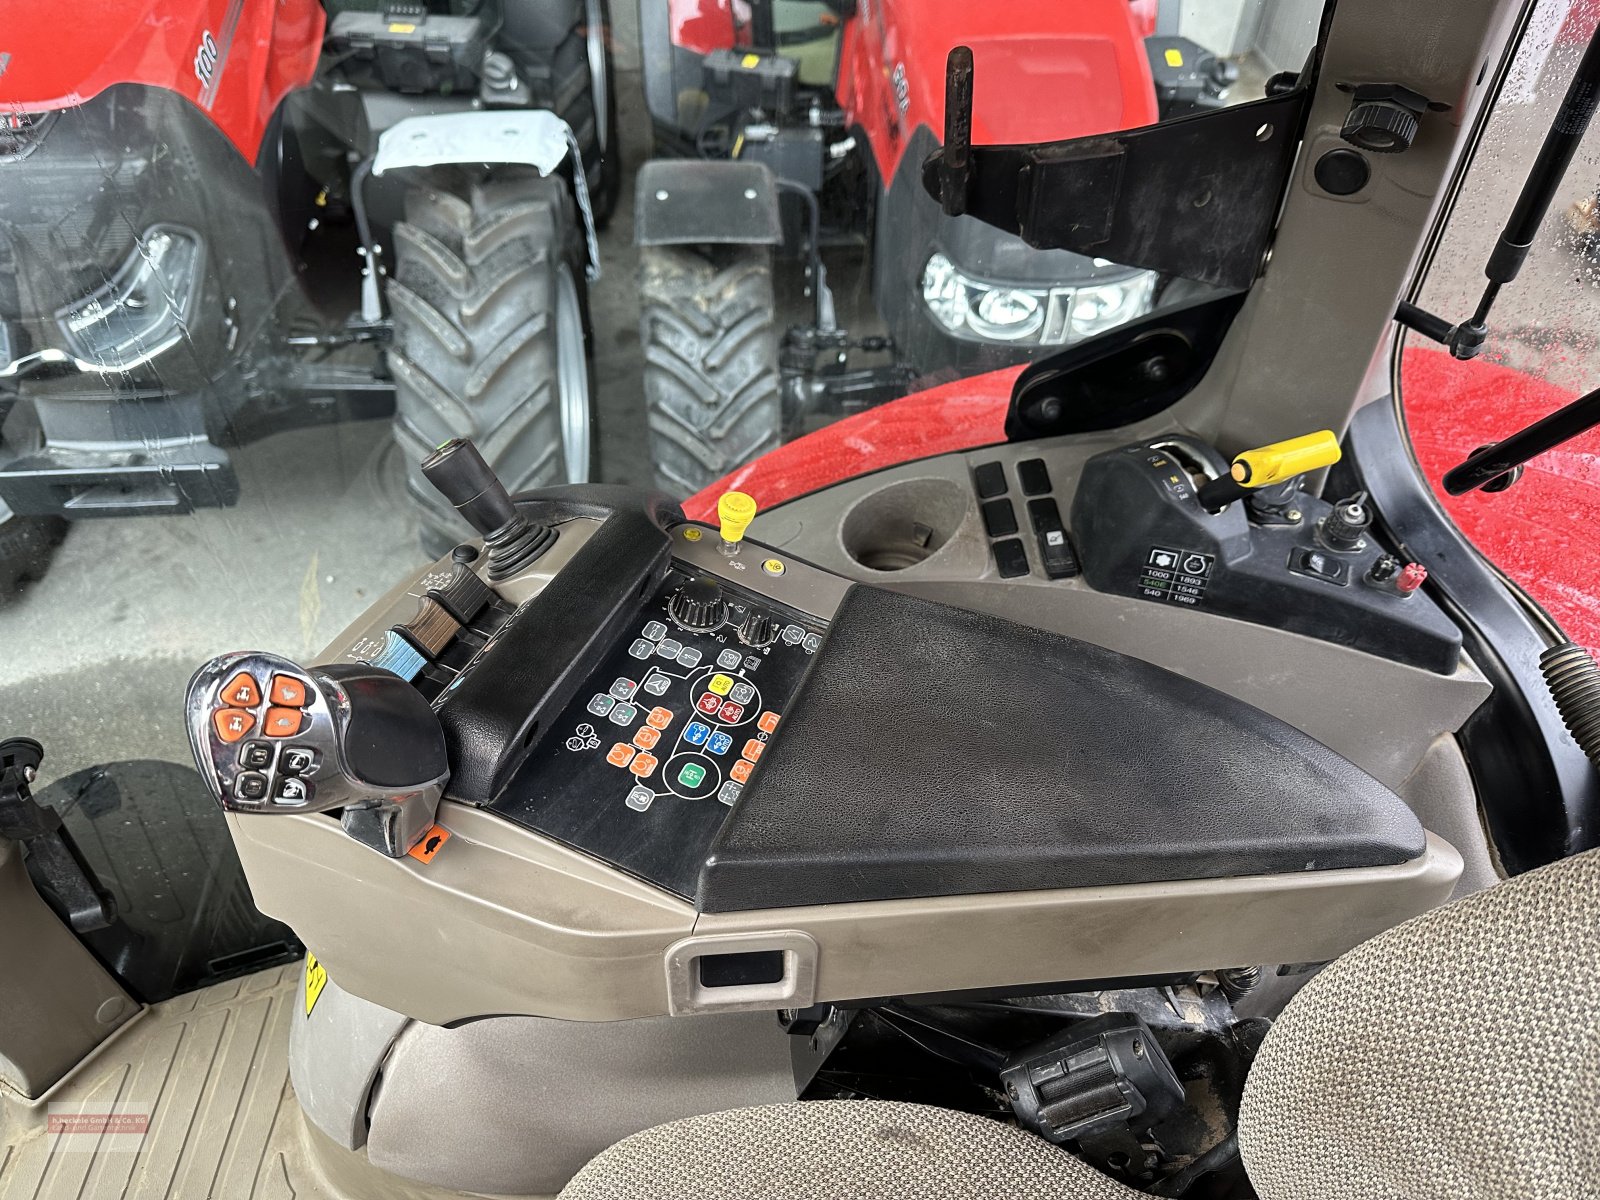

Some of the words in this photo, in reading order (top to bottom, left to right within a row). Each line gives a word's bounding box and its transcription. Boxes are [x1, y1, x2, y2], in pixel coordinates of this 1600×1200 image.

[194, 30, 217, 89] 100
[1148, 570, 1169, 579] 1000
[1180, 576, 1201, 585] 1893
[1144, 588, 1161, 597] 540
[1174, 594, 1196, 604] 1969
[660, 680, 669, 691] AUTO
[721, 680, 731, 692] AUTO
[731, 708, 741, 720] AUTO
[721, 740, 730, 752] AUTO
